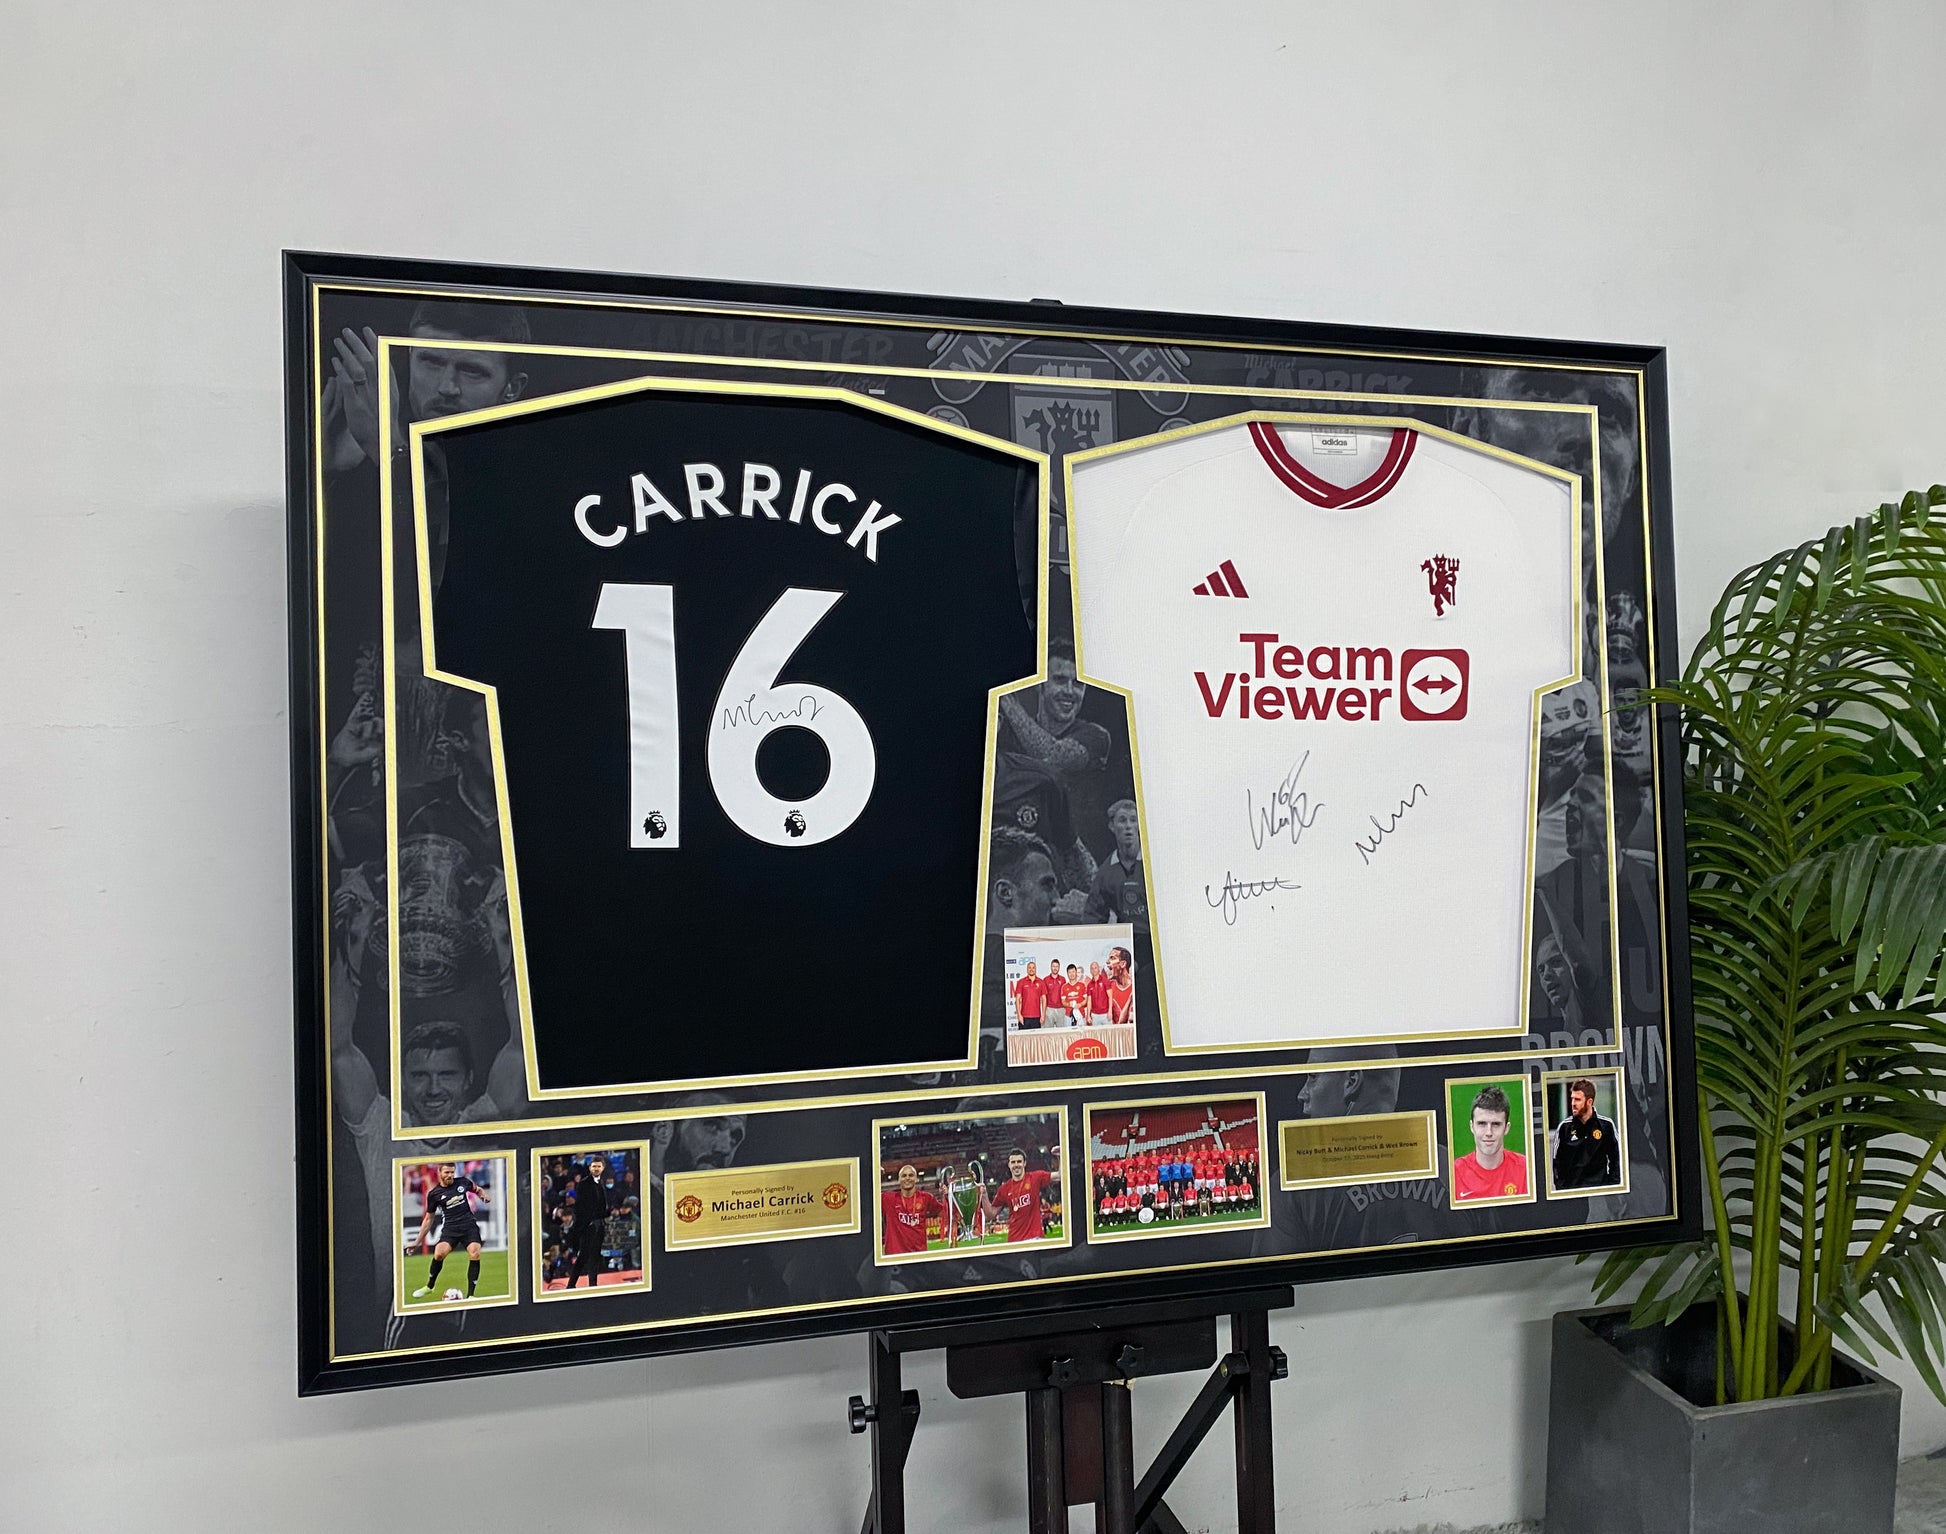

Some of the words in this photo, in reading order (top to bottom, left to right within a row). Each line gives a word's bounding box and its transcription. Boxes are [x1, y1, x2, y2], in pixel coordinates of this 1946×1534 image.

[1245, 367, 1415, 414] CARRICK
[1322, 438, 1347, 446] adidas
[574, 462, 902, 563] CARRICK
[1240, 633, 1393, 681] Team
[590, 582, 877, 849] 16
[1194, 672, 1392, 721] Viewer
[711, 1197, 764, 1212] Michael
[769, 1192, 814, 1207] Carrick
[731, 1187, 763, 1196] Personally
[765, 1185, 785, 1193] Signed
[1346, 1180, 1445, 1212] BROWN
[720, 1213, 757, 1221] Manchester
[759, 1209, 780, 1218] United
